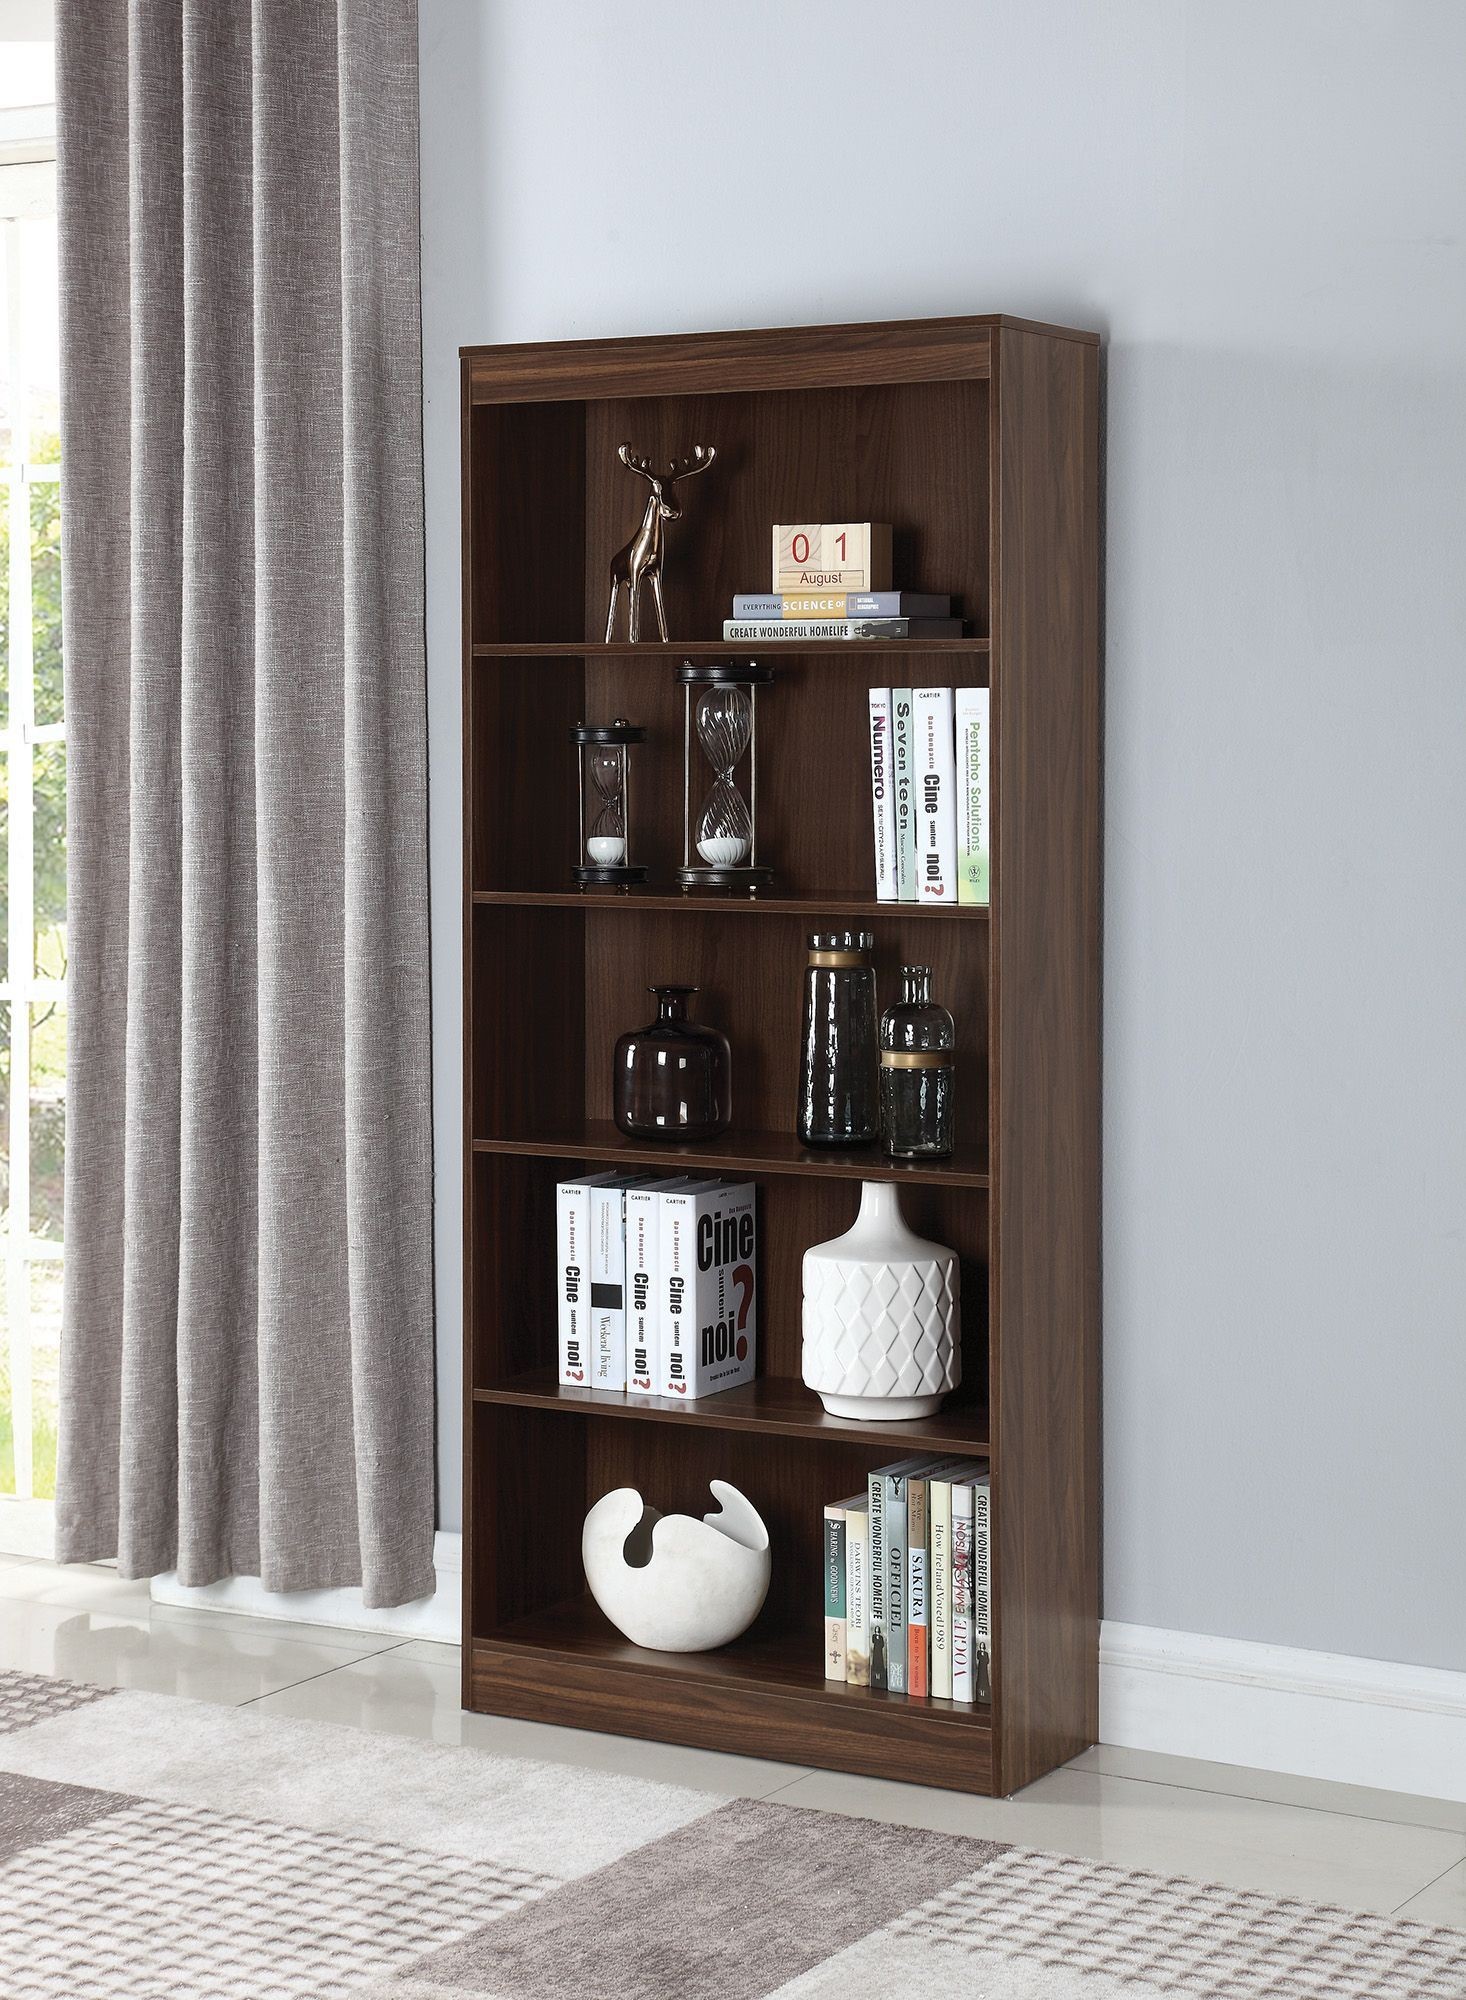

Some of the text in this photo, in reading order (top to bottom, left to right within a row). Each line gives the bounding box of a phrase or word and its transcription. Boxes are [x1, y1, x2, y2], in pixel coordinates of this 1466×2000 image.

[800, 572, 842, 587] August
[783, 600, 834, 611] SCIENCE
[730, 626, 848, 638] CREATE WONDERFUL HOMELIFE
[873, 716, 885, 799] Numero
[897, 702, 910, 830] Seven teen
[970, 722, 981, 781] Pentaho
[925, 774, 940, 813] Cine
[971, 787, 982, 852] Solutions
[925, 854, 944, 896] noi?
[698, 1211, 754, 1272] Cine
[566, 1266, 580, 1303] Cine
[634, 1273, 649, 1310] Cine
[669, 1277, 684, 1314] Cine
[566, 1340, 584, 1381] noi?
[595, 1316, 611, 1377] Weekend living
[633, 1348, 650, 1390] noi?
[668, 1353, 686, 1394] noi?
[917, 1494, 923, 1506] We
[872, 1481, 882, 1619] CREATE WONDERFUL HOMELIFE
[935, 1524, 943, 1549] How
[854, 1542, 862, 1593] DARWINS
[978, 1495, 988, 1635] CREATE WONDERFUL HOMELIFE
[890, 1548, 902, 1632] OFFICIEL
[912, 1555, 923, 1617] SAKURA
[955, 1578, 965, 1614] EMMA
[831, 1623, 840, 1643] Casey
[954, 1620, 967, 1677] VOGUE
[914, 1656, 920, 1664] be
